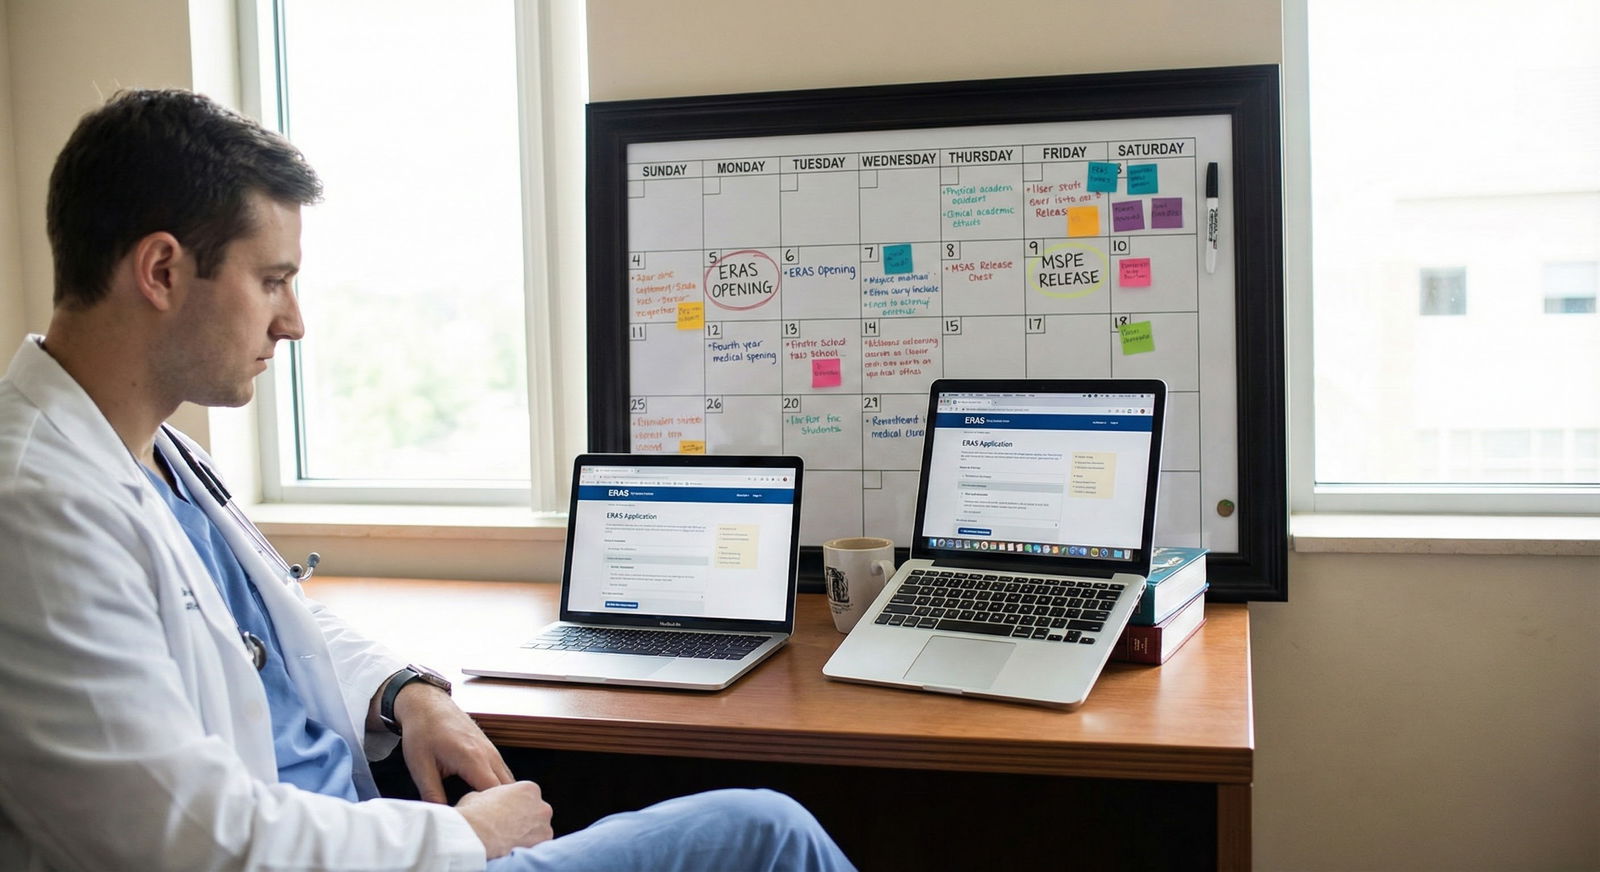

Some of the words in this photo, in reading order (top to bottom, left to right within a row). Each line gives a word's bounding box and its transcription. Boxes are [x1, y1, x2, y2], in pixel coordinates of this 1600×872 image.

[1043, 146, 1087, 159] FRIDAY
[1118, 142, 1184, 156] SATURDAY
[862, 153, 936, 167] WEDNESDAY
[949, 149, 1014, 163] THURSDAY
[717, 161, 766, 174] MONDAY
[793, 157, 846, 170] TUESDAY
[642, 164, 688, 177] SUNDAY
[946, 243, 954, 258] 8
[1029, 241, 1038, 255] 9
[1113, 240, 1127, 252] 10
[709, 251, 717, 265] 5
[785, 248, 795, 262] 6
[864, 247, 873, 259] 7
[632, 254, 640, 267] 4
[951, 262, 975, 273] MSAS
[980, 260, 1013, 270] Release
[1042, 252, 1084, 270] MSPE
[719, 262, 758, 280] ERAS
[789, 266, 815, 278] ERAS
[818, 265, 856, 280] Opening
[1039, 270, 1100, 289] RELEASE
[712, 280, 773, 298] OPENING
[785, 323, 798, 335] 13
[864, 321, 876, 334] 14
[945, 320, 959, 332] 15
[1029, 318, 1042, 330] 17
[1114, 316, 1127, 329] 18
[632, 327, 643, 338] 11
[707, 324, 720, 337] 12
[712, 341, 740, 351] Fourth
[743, 341, 763, 351] year
[713, 352, 743, 363] medical
[631, 398, 646, 410] 25
[707, 398, 722, 410] 26
[784, 398, 799, 409] 20
[965, 416, 985, 425] ERAS
[871, 428, 902, 439] medical
[980, 440, 1013, 448] Application
[608, 489, 629, 497] ERAS
